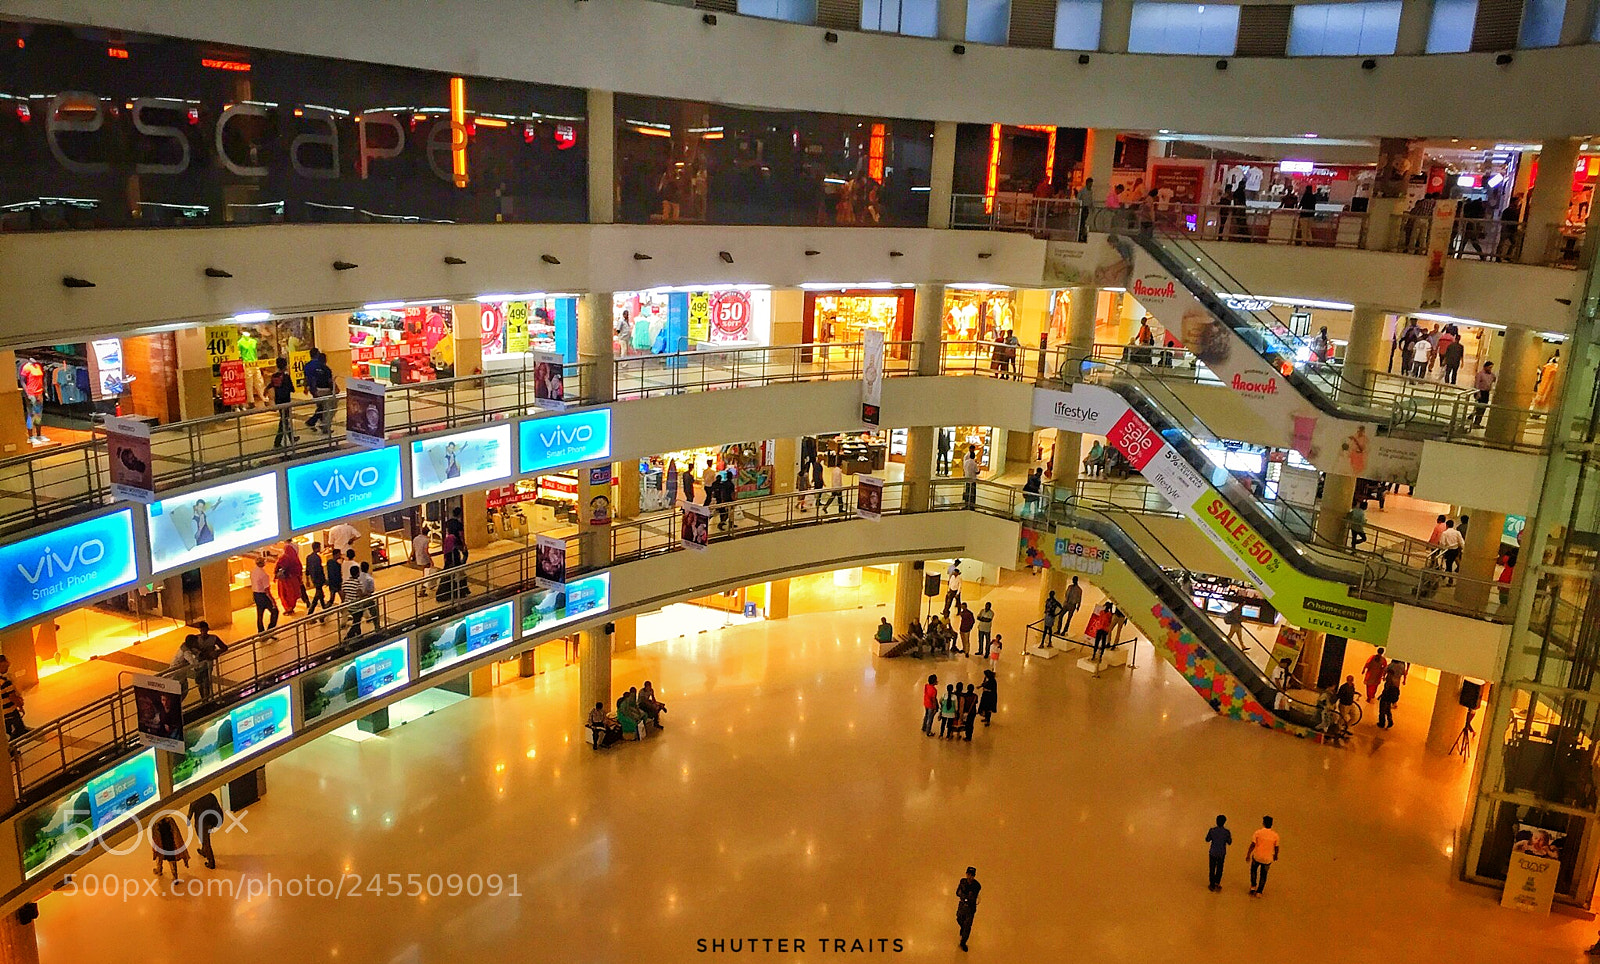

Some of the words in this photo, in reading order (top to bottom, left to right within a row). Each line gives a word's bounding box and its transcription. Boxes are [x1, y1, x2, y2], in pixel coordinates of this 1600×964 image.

[510, 308, 526, 320] 499
[692, 302, 707, 312] 499
[720, 303, 743, 321] 50
[1054, 402, 1099, 422] lifestyle
[540, 425, 593, 448] vivo
[1119, 434, 1140, 456] 50
[1124, 422, 1152, 450] sale
[546, 448, 566, 459] Smart
[567, 445, 586, 454] Phone
[1165, 450, 1178, 466] 5%
[313, 466, 379, 497] vivo
[1154, 473, 1180, 499] lifestyle
[322, 497, 347, 510] Smart
[348, 491, 372, 503] Phone
[505, 495, 519, 503] SALE
[1207, 499, 1249, 541] SALE
[1248, 540, 1273, 565] 50
[17, 538, 105, 584] vivo
[31, 581, 64, 600] Smart
[66, 569, 98, 587] Phone
[1308, 617, 1334, 629] LEVEL
